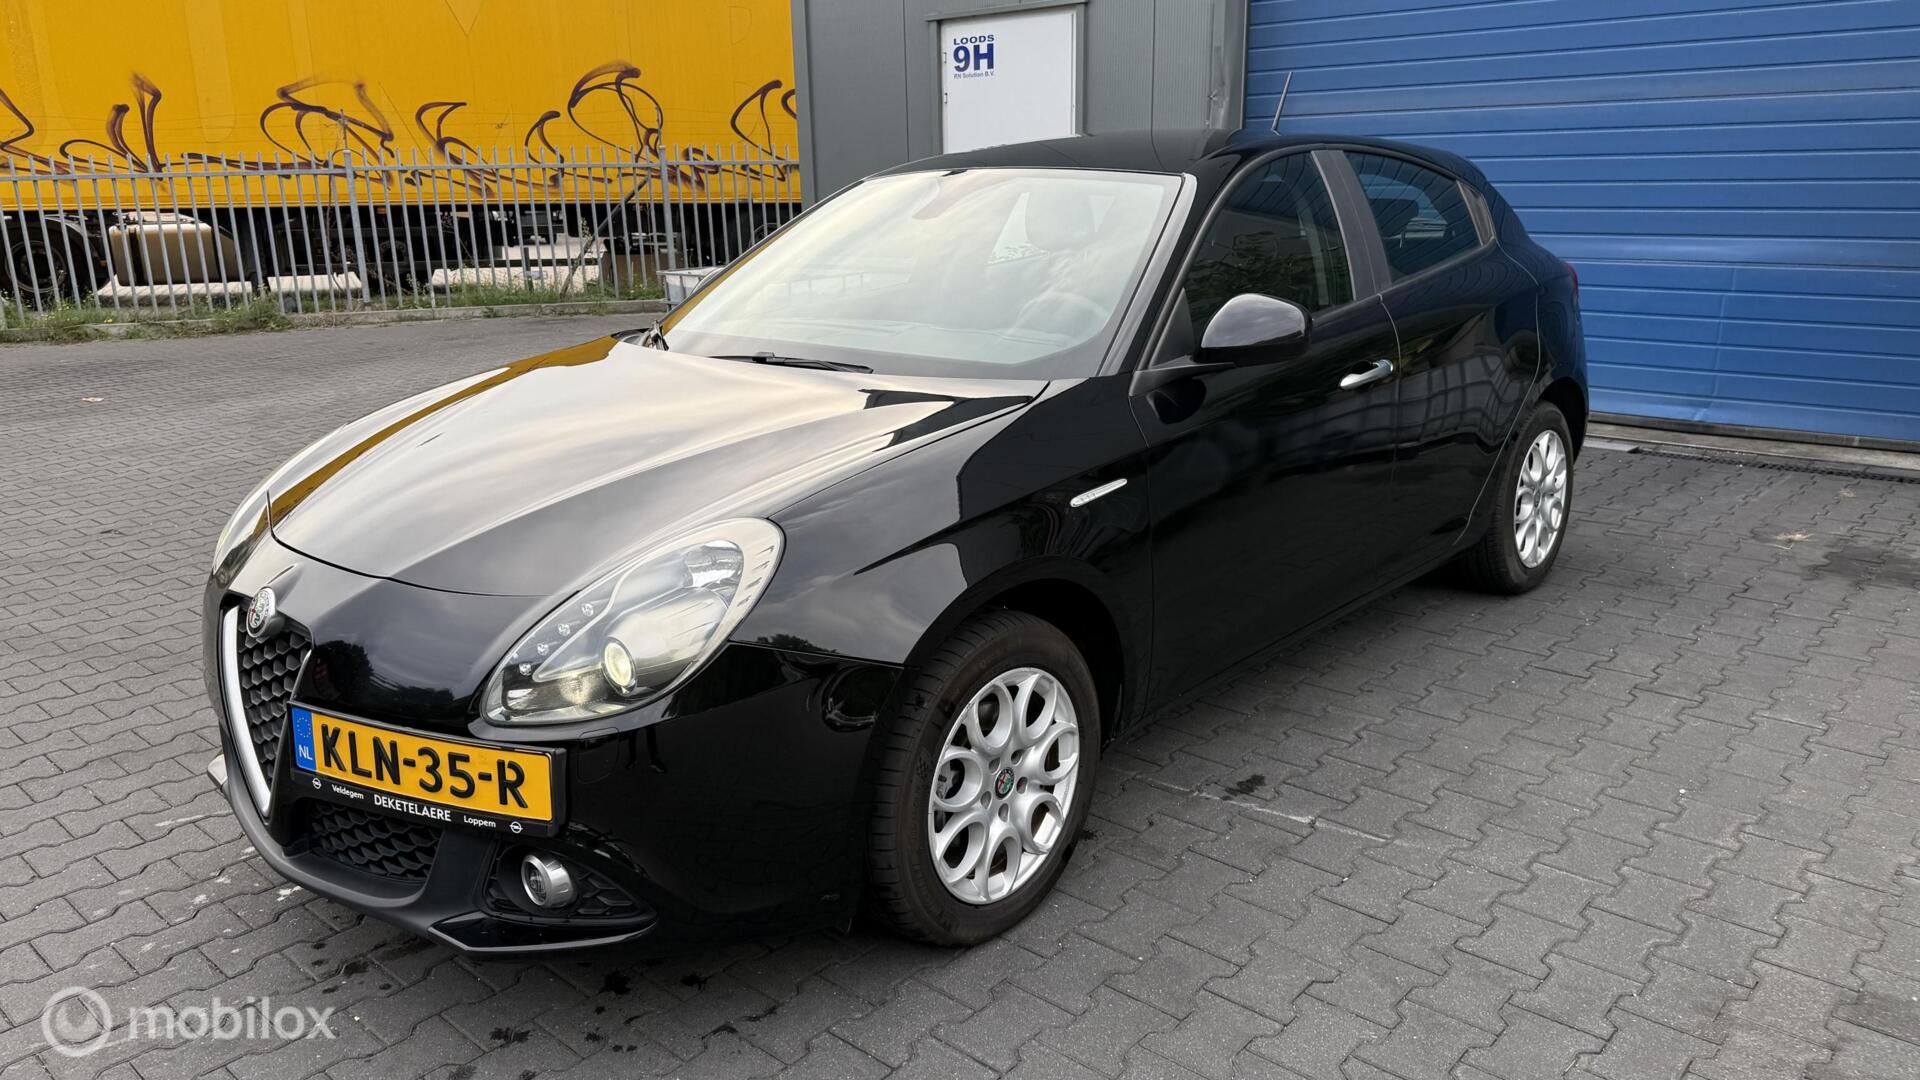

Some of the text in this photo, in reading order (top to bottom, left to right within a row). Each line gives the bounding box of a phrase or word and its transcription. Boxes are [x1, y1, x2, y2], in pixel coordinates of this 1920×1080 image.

[953, 34, 995, 45] LOODS
[953, 43, 994, 72] 9H
[298, 744, 313, 761] NL
[321, 723, 528, 809] KLN-35-R
[331, 784, 364, 800] Veldegem
[374, 794, 452, 822] DEKETELAERE
[463, 815, 497, 828] Loppem
